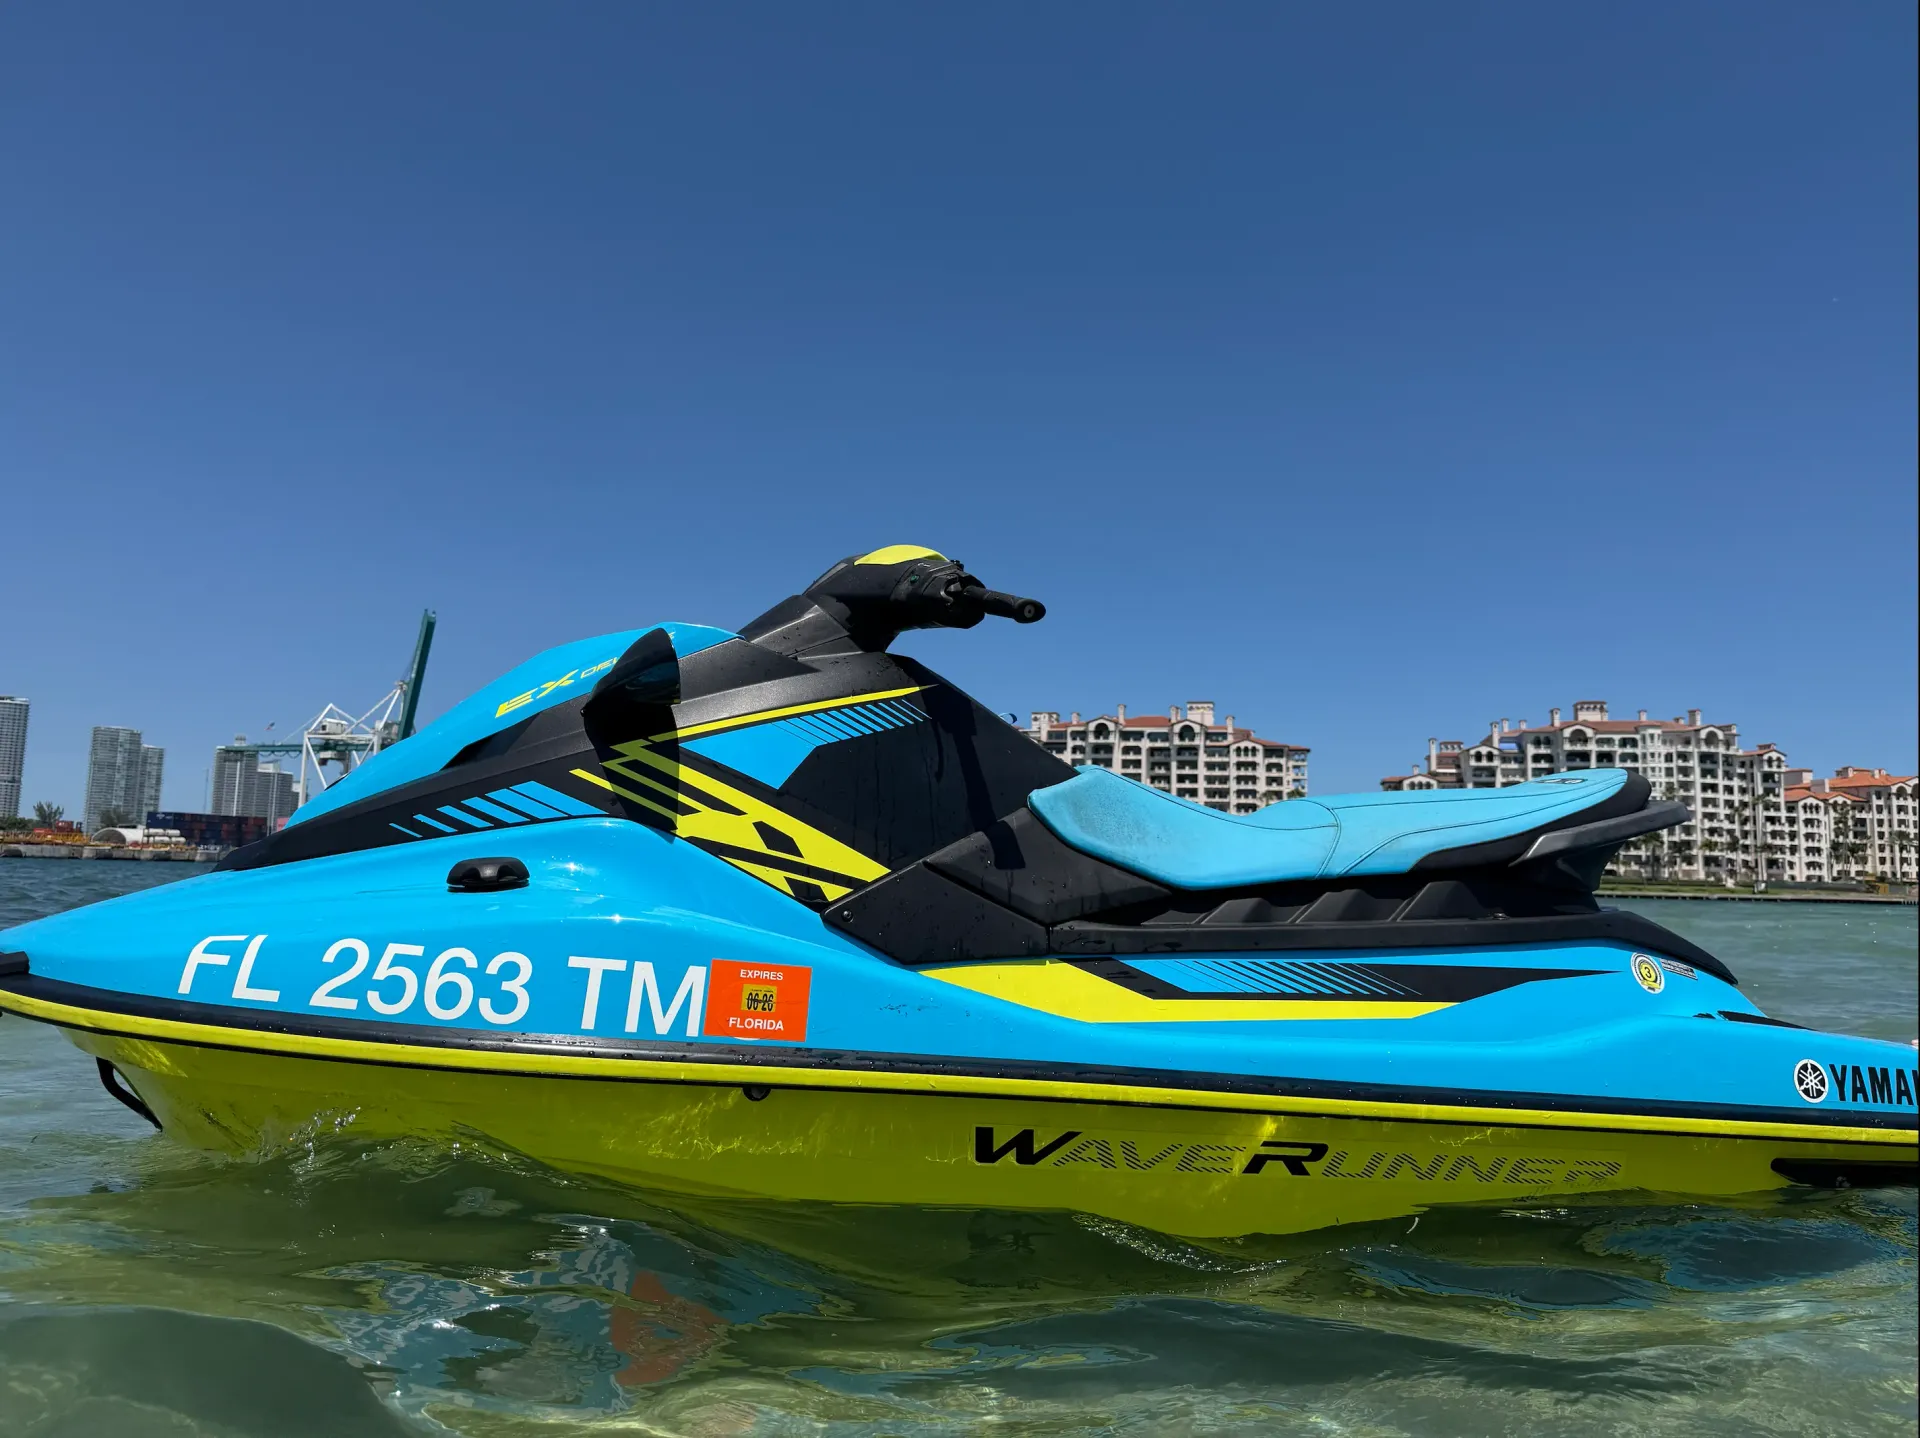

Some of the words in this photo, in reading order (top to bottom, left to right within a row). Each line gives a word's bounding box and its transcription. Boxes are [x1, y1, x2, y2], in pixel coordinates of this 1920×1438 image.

[495, 669, 579, 718] EX
[740, 969, 784, 981] EXPIRES
[1644, 966, 1652, 979] 3
[177, 934, 281, 1002] FL
[308, 938, 533, 1025] 2563
[567, 955, 707, 1038] TM
[728, 1017, 784, 1031] FLORIDA
